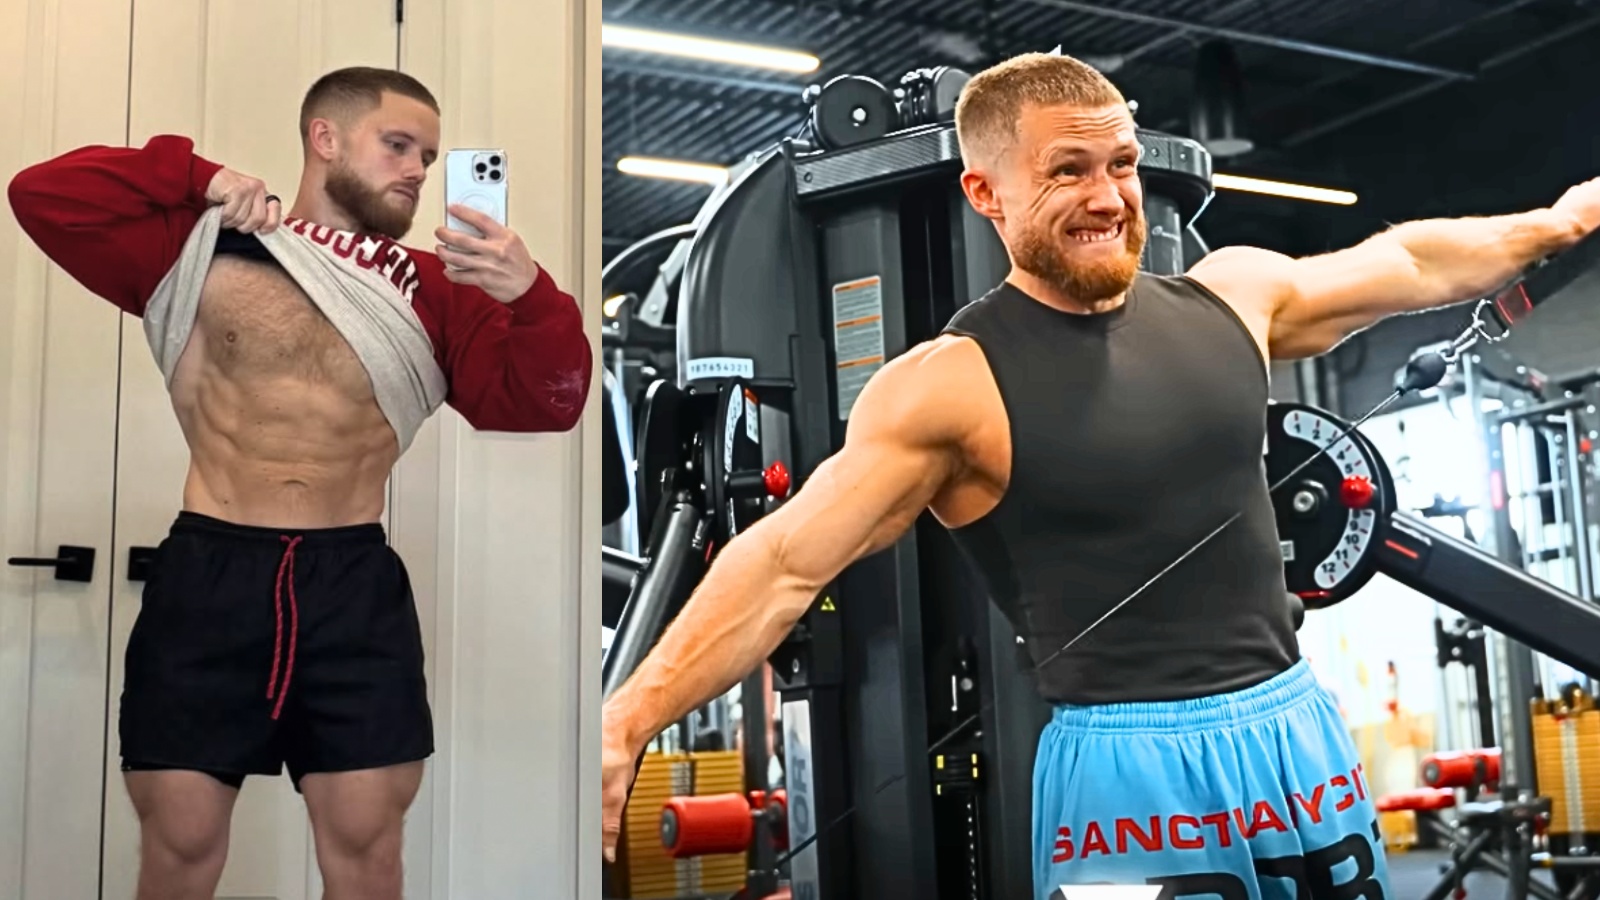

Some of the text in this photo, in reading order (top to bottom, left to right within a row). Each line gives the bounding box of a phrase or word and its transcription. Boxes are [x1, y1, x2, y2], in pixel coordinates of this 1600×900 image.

[1293, 423, 1301, 434] 1
[1312, 429, 1321, 440] 2
[1336, 450, 1346, 461] 4
[1344, 463, 1353, 474] 5
[1349, 520, 1359, 531] 9
[1344, 534, 1360, 545] 10
[1334, 548, 1348, 561] 11
[1321, 561, 1336, 574] 12
[1052, 784, 1326, 864] SANCTUAY
